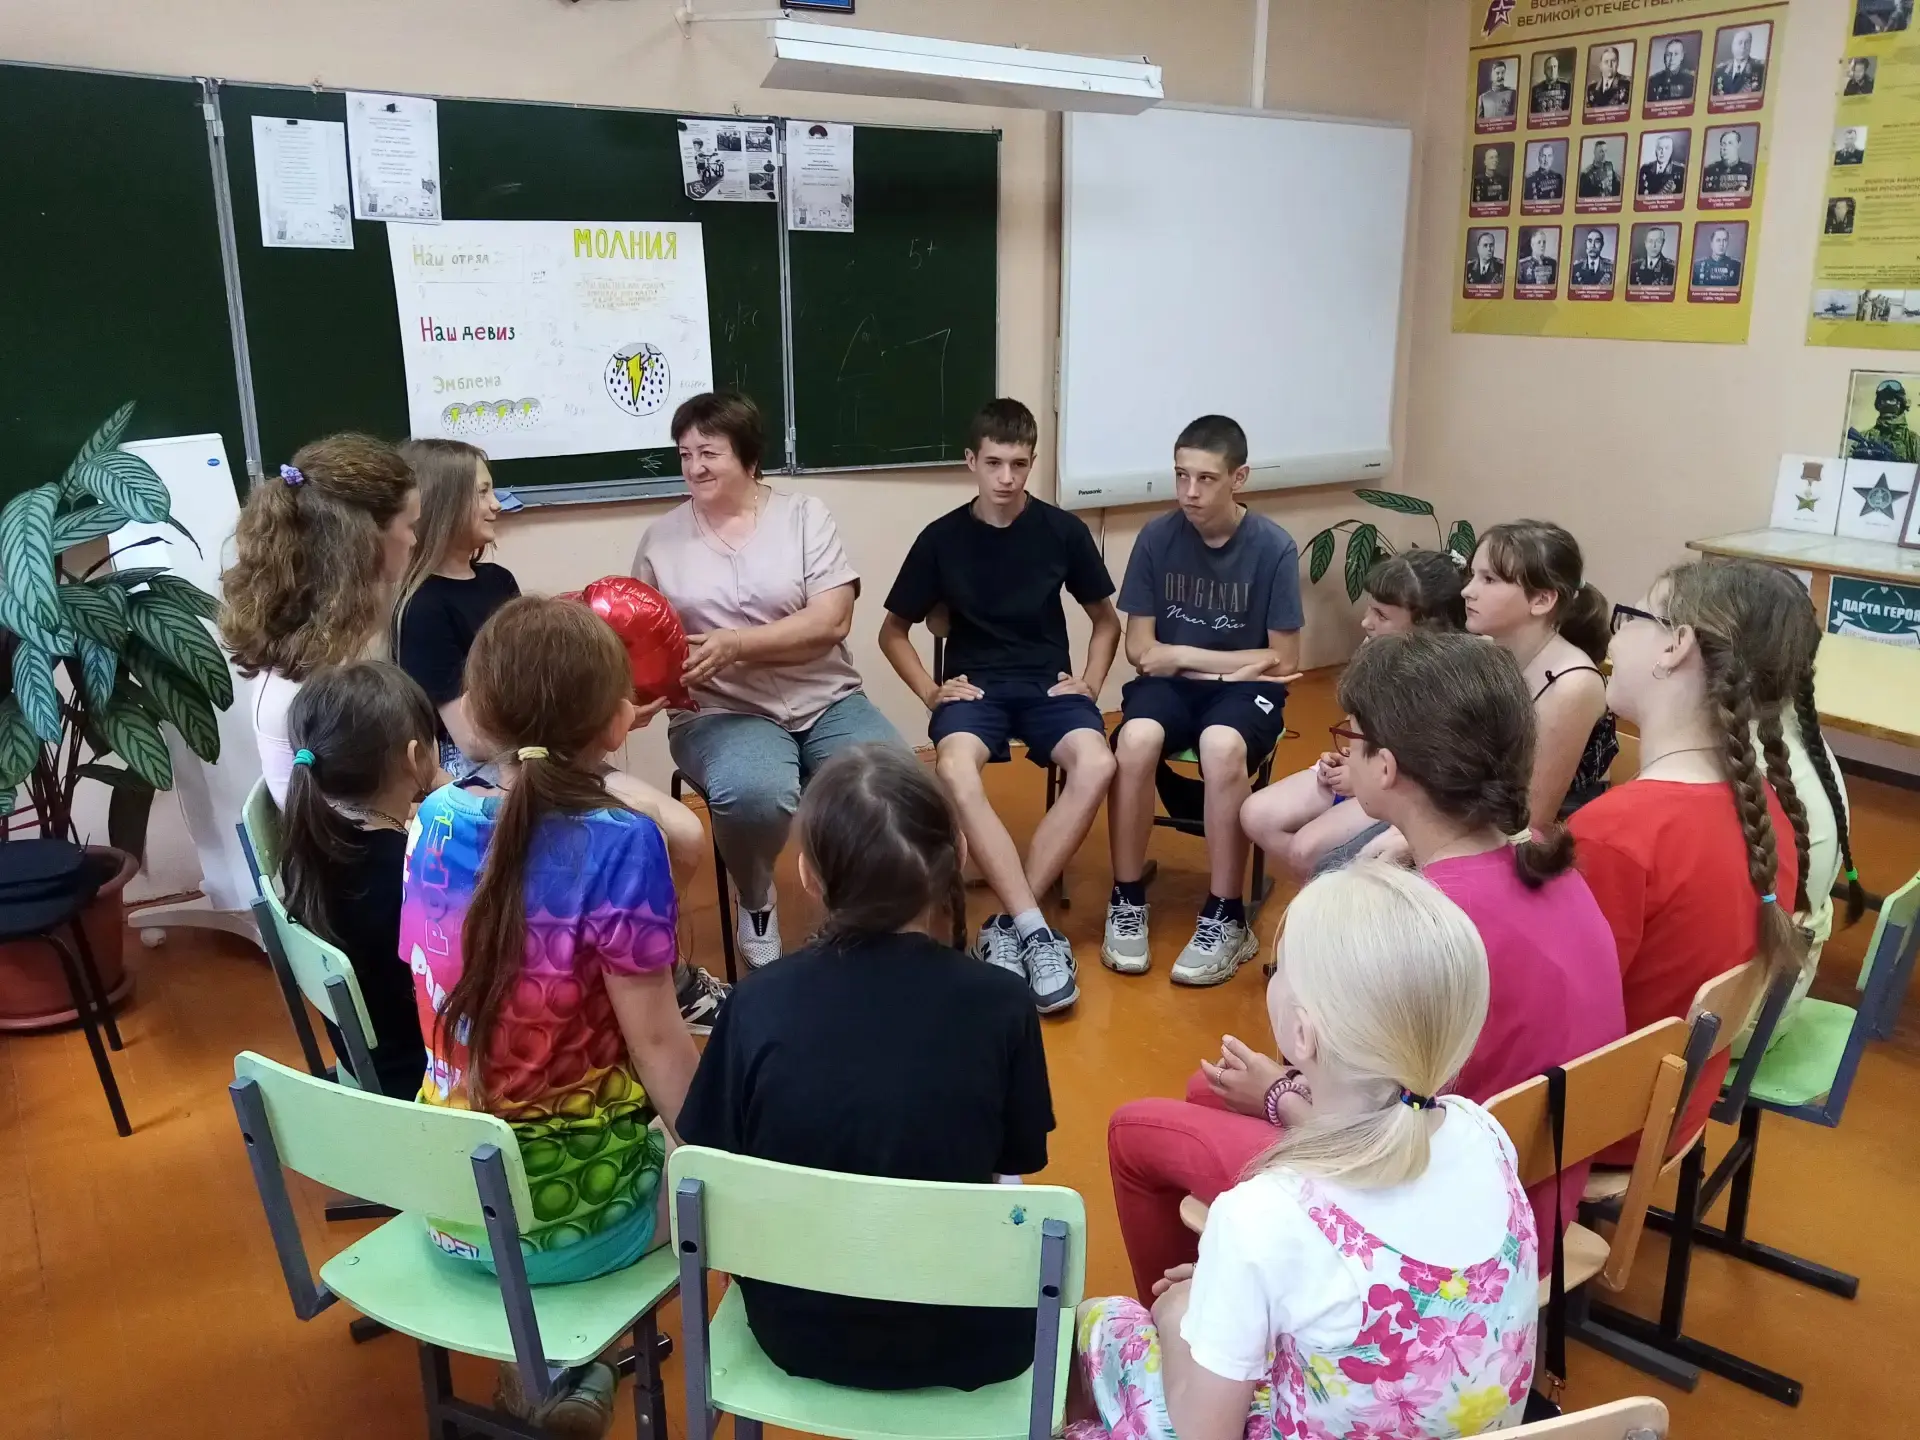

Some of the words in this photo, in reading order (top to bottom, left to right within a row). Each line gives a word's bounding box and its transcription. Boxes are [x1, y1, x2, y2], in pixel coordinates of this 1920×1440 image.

[1517, 6, 1580, 27] ВЕЛИКОЙ
[573, 228, 678, 260] МОЛНИЯ
[420, 316, 457, 342] Наш
[462, 325, 516, 342] девиз
[432, 374, 503, 394] Эмблема
[1078, 487, 1102, 496] Panasonic
[1841, 598, 1881, 616] ПАРТА
[1883, 605, 1920, 623] ГЕРОЯ
